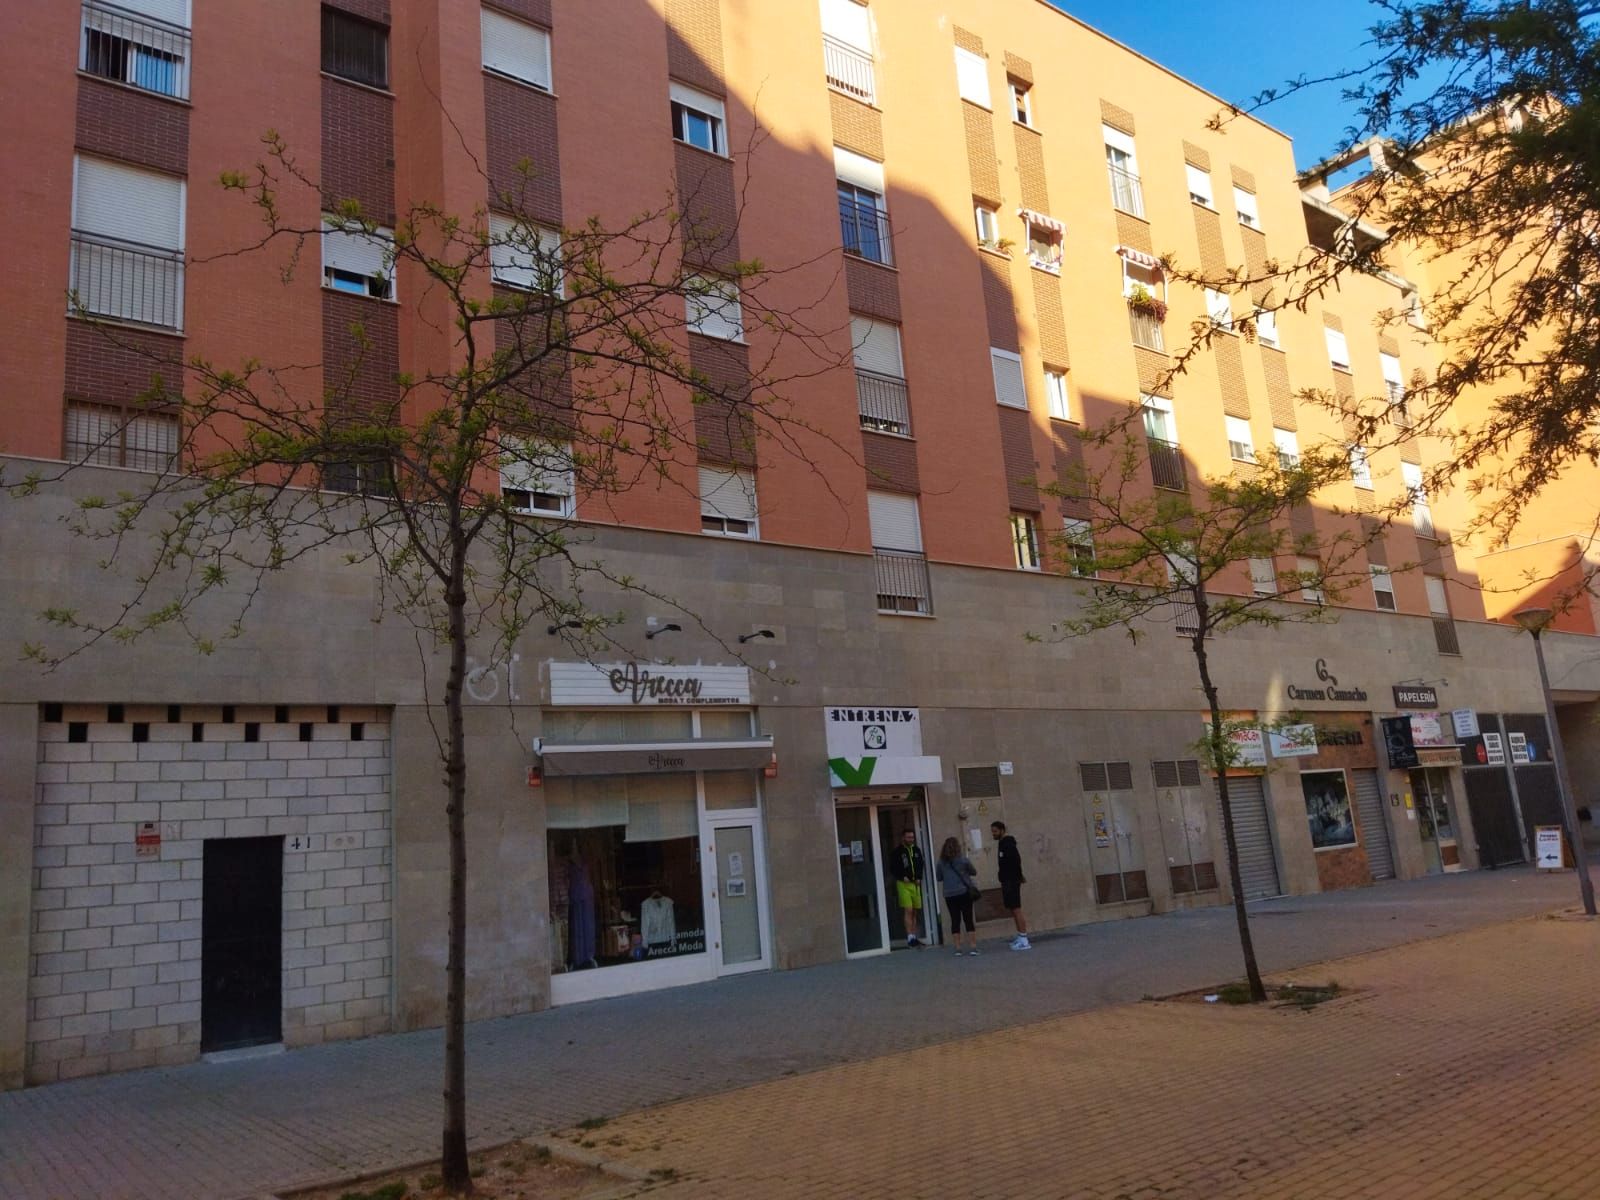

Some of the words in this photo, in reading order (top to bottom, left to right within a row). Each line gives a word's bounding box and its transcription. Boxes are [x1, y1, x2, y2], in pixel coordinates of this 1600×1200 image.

[610, 661, 703, 704] Arecca
[1287, 684, 1325, 701] Carmen
[1326, 685, 1368, 702] Camacho
[648, 752, 685, 770] Arecca
[678, 940, 704, 952] Moda
